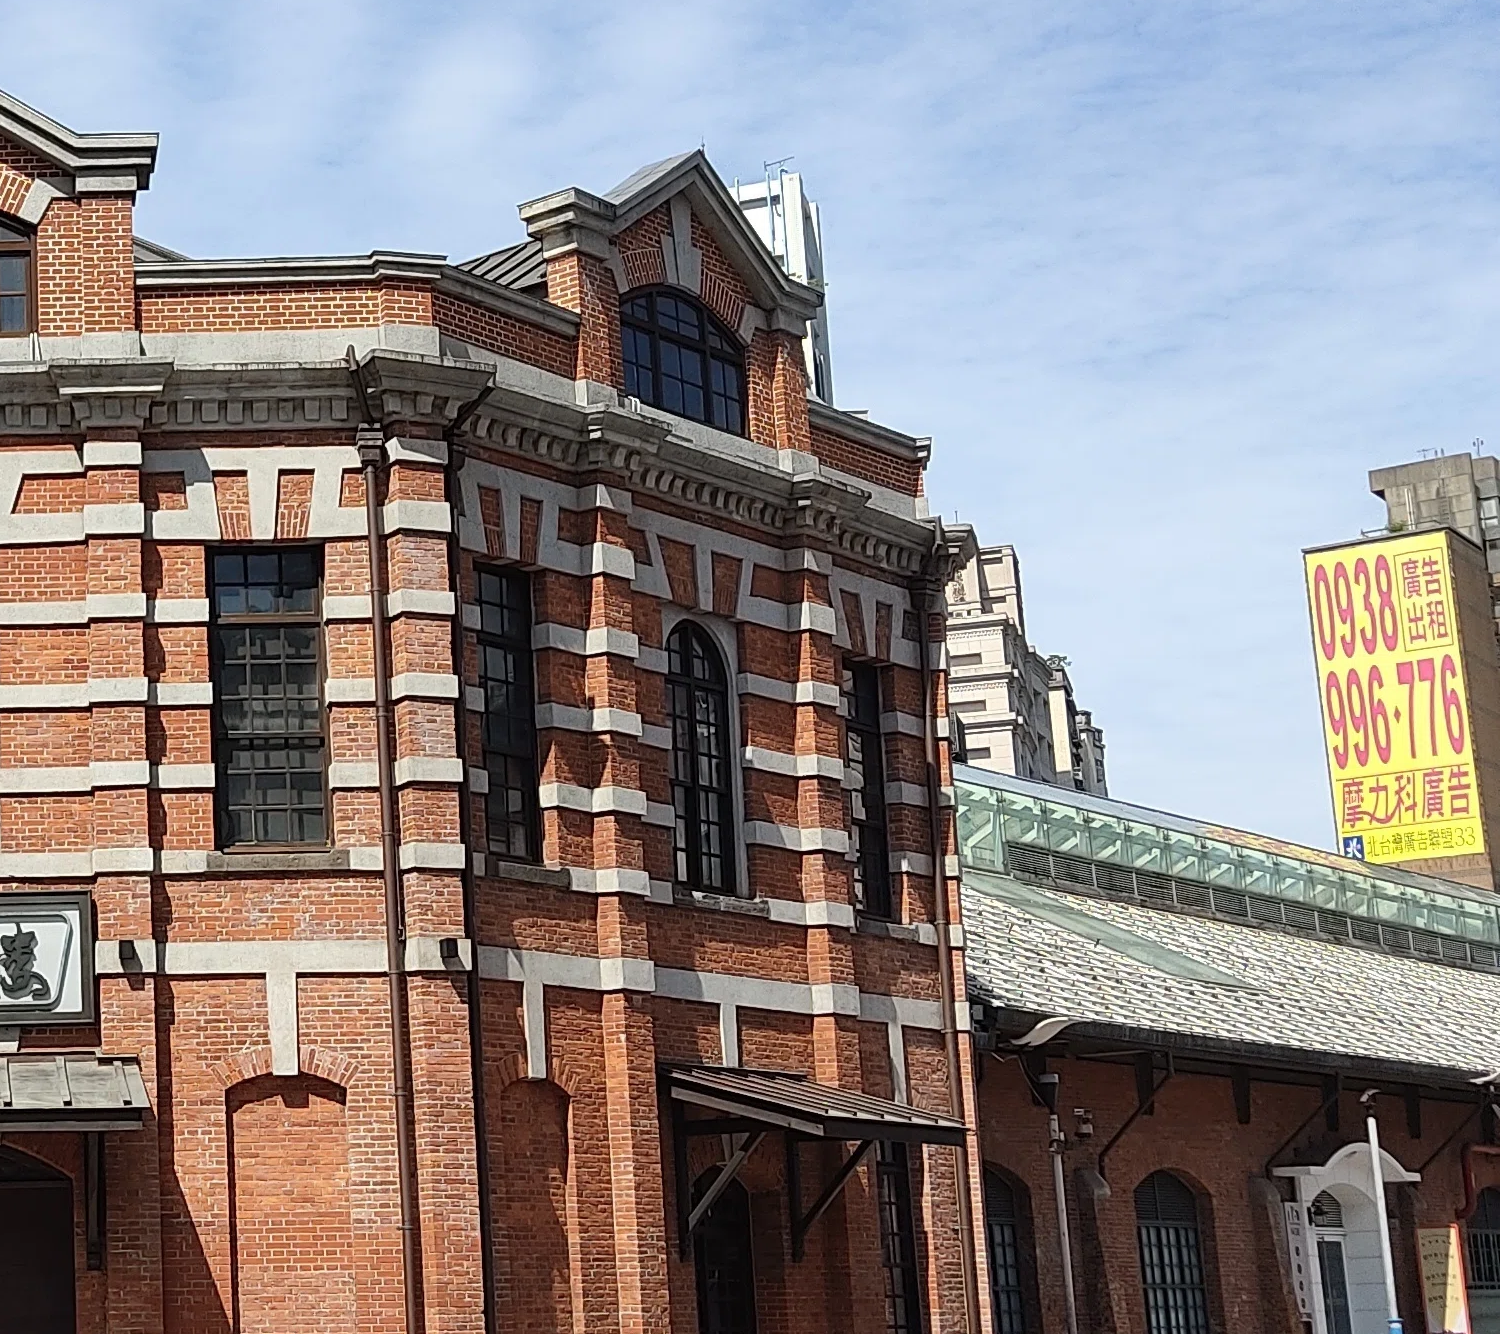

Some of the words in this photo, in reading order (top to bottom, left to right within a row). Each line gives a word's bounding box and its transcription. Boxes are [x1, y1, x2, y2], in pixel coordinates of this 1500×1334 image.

[1401, 555, 1442, 599] 廣告
[1314, 554, 1398, 661] 0938
[1407, 600, 1449, 644] 出租
[1342, 765, 1471, 828] 摩力科廣告
